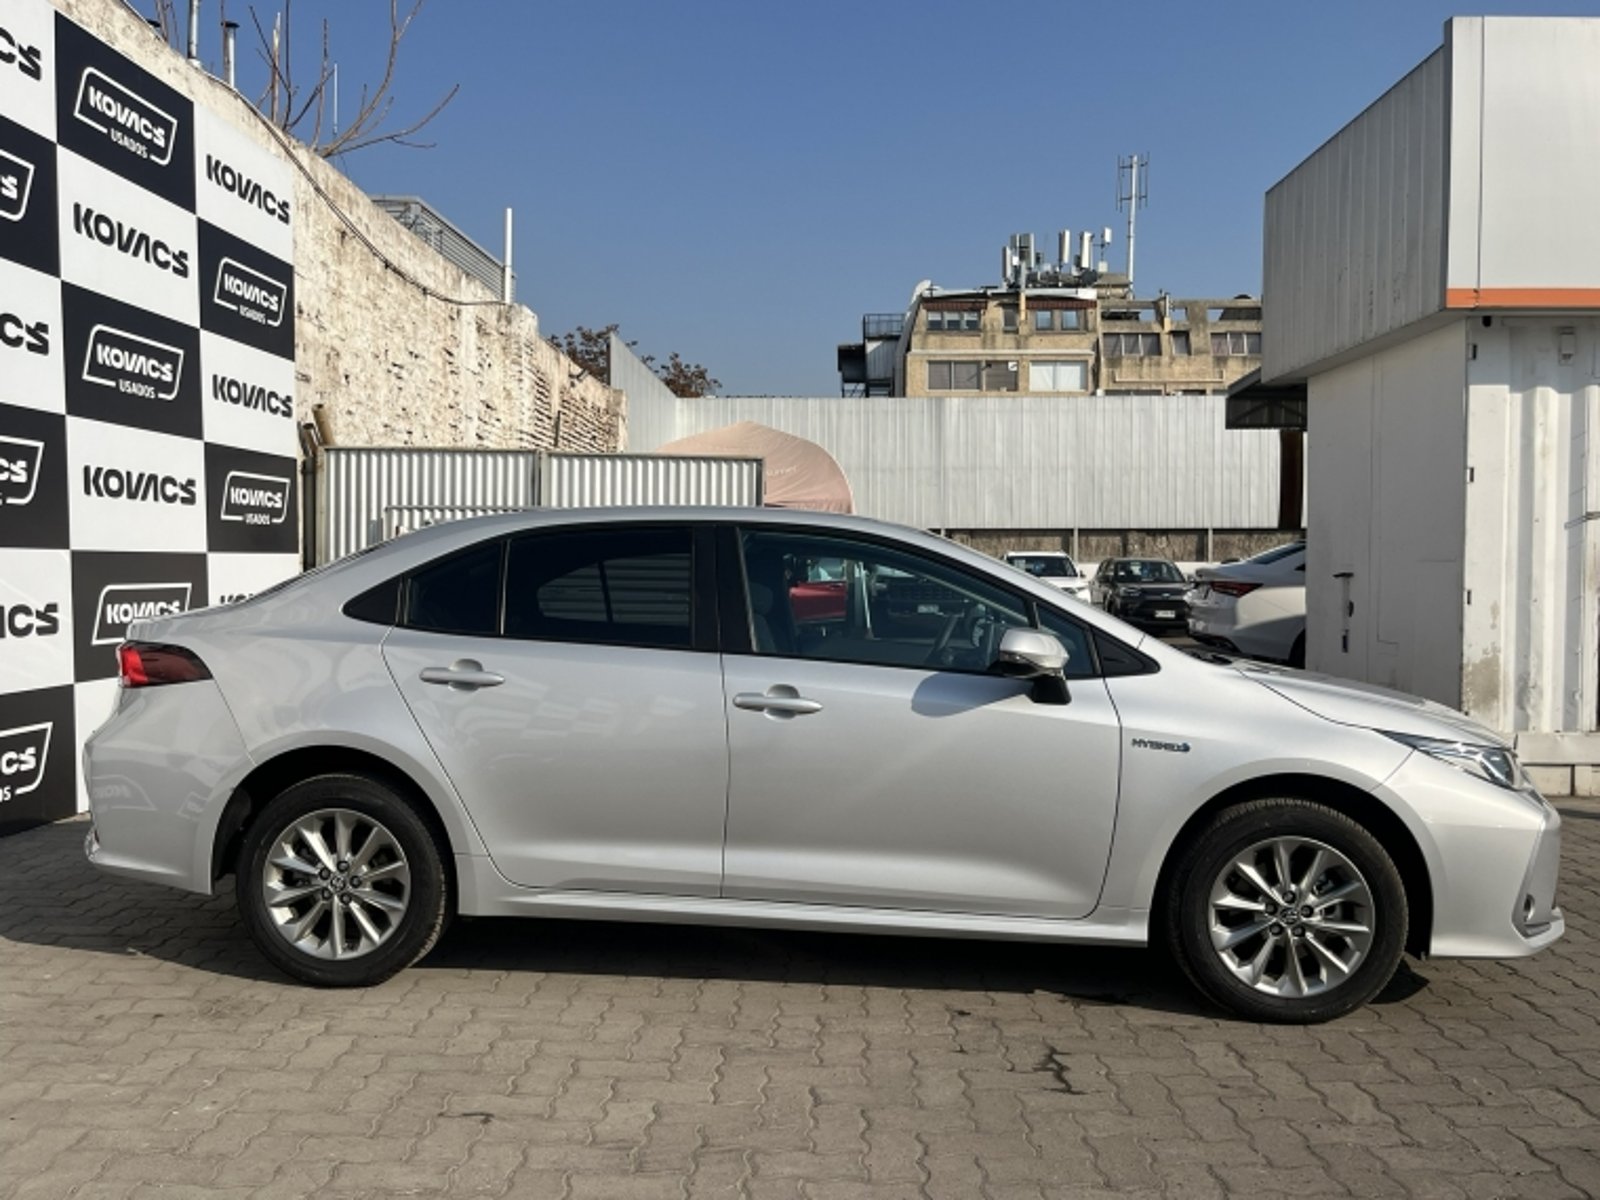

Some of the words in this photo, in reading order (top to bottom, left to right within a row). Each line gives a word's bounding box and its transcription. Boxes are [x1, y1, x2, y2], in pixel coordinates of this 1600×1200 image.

[89, 85, 166, 149] KOVACS
[206, 153, 290, 226] KOVACS
[73, 201, 190, 279] KOVACS
[224, 272, 279, 313] KOVACS
[96, 342, 173, 383] KOVACS
[212, 373, 293, 419] KOVACS
[83, 464, 197, 506] KOVACS
[230, 486, 283, 509] KOVACS
